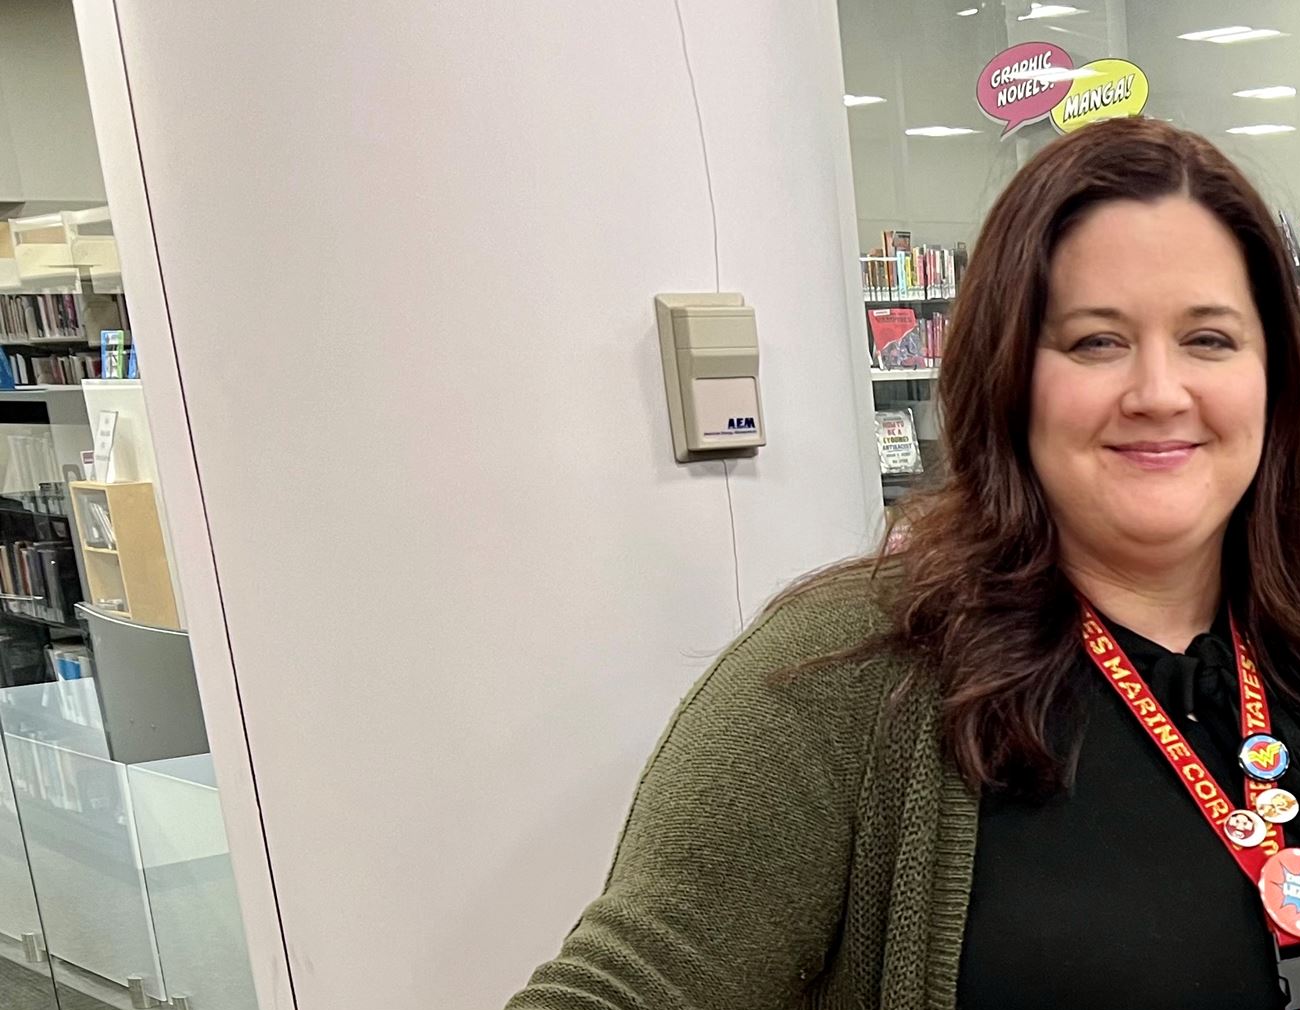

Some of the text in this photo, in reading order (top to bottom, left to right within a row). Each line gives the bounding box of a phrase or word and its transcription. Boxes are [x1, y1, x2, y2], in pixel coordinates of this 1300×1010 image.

[990, 51, 1053, 88] GRAPHIC
[1062, 73, 1135, 123] MANGA!
[727, 417, 756, 430] AEM
[1242, 655, 1267, 735] TATES
[1103, 656, 1231, 826] MARINE COR
